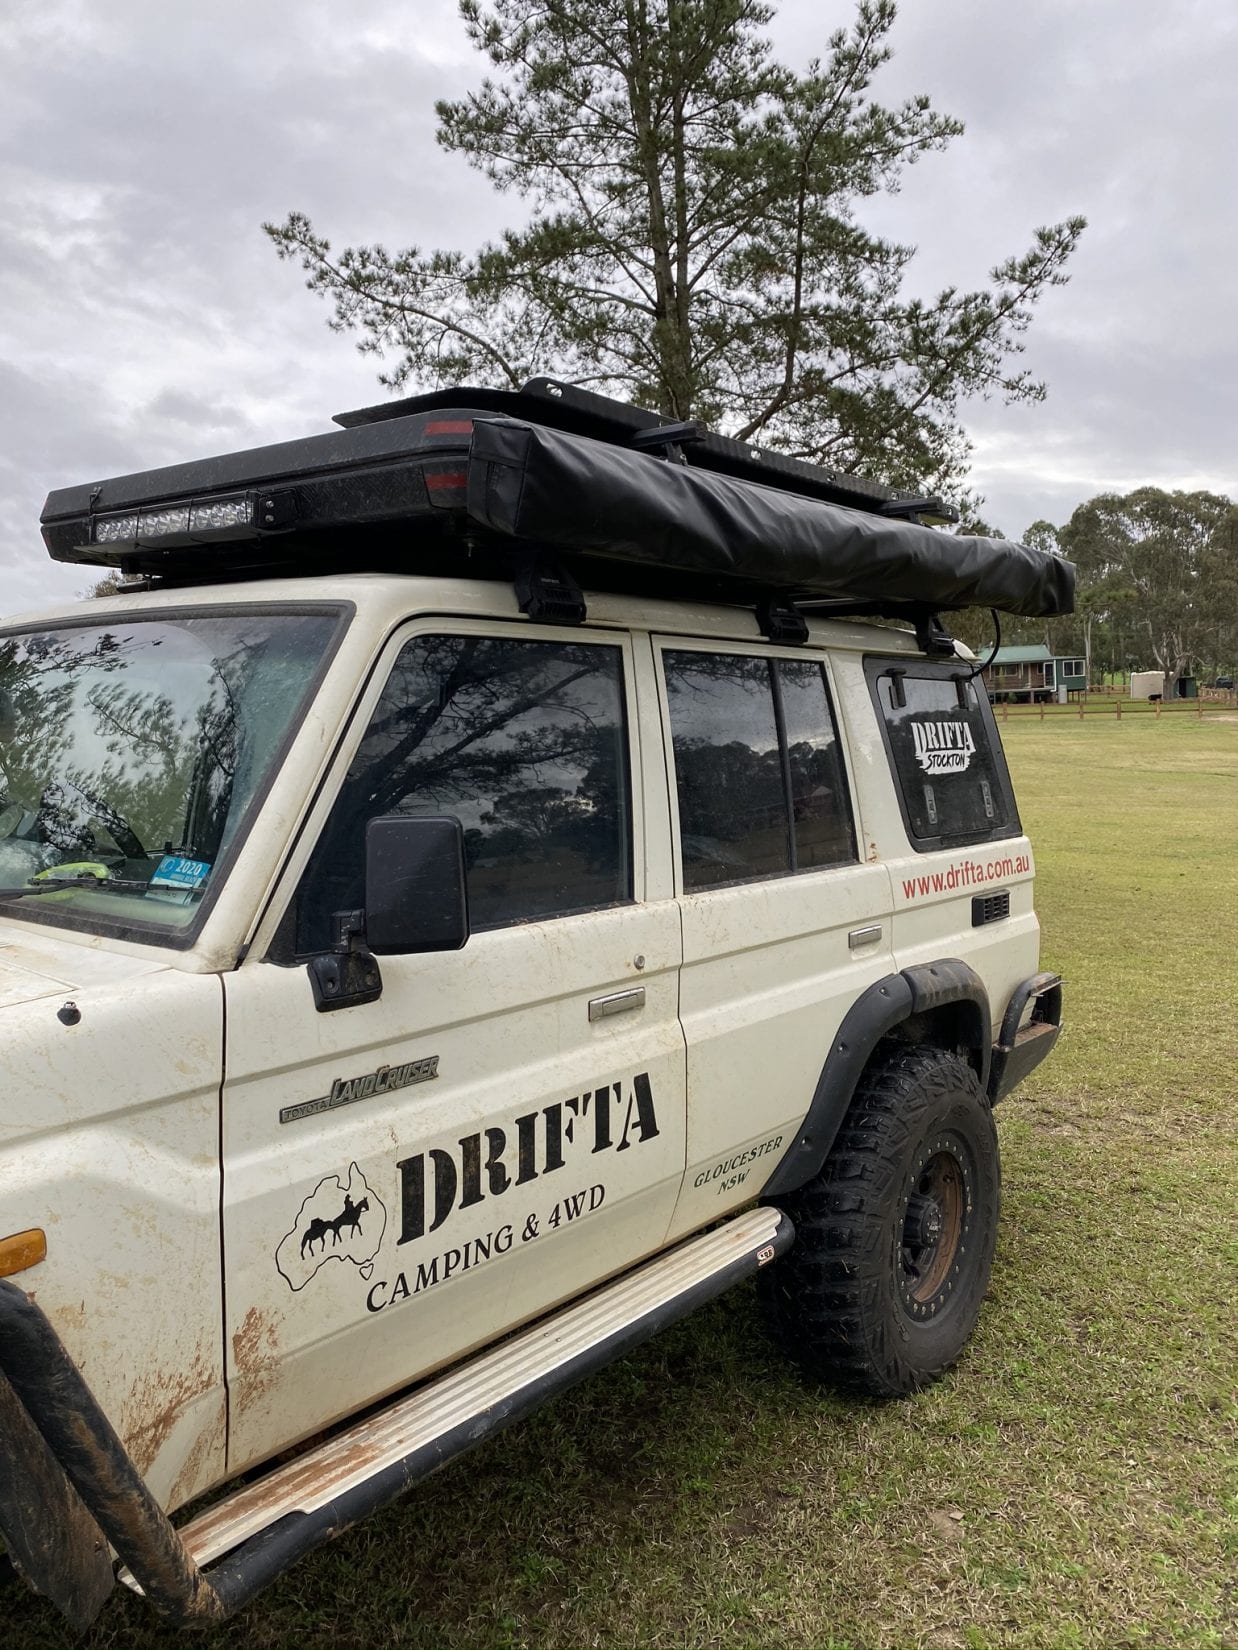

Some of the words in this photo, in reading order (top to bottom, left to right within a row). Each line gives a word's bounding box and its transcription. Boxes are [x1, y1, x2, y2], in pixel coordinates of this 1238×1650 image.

[911, 721, 976, 753] DRIFTA
[924, 753, 965, 770] STOCKTON
[176, 860, 203, 876] 2020
[902, 856, 1030, 899] www.drifta.com.au
[284, 1101, 328, 1120] TOYOTA
[396, 1072, 660, 1246] DRIFTA
[694, 1136, 783, 1188] GLOUCESTER
[717, 1168, 751, 1196] NSW
[366, 1224, 513, 1312] CAMPING
[521, 1213, 540, 1242] &
[547, 1183, 606, 1229] 4WD
